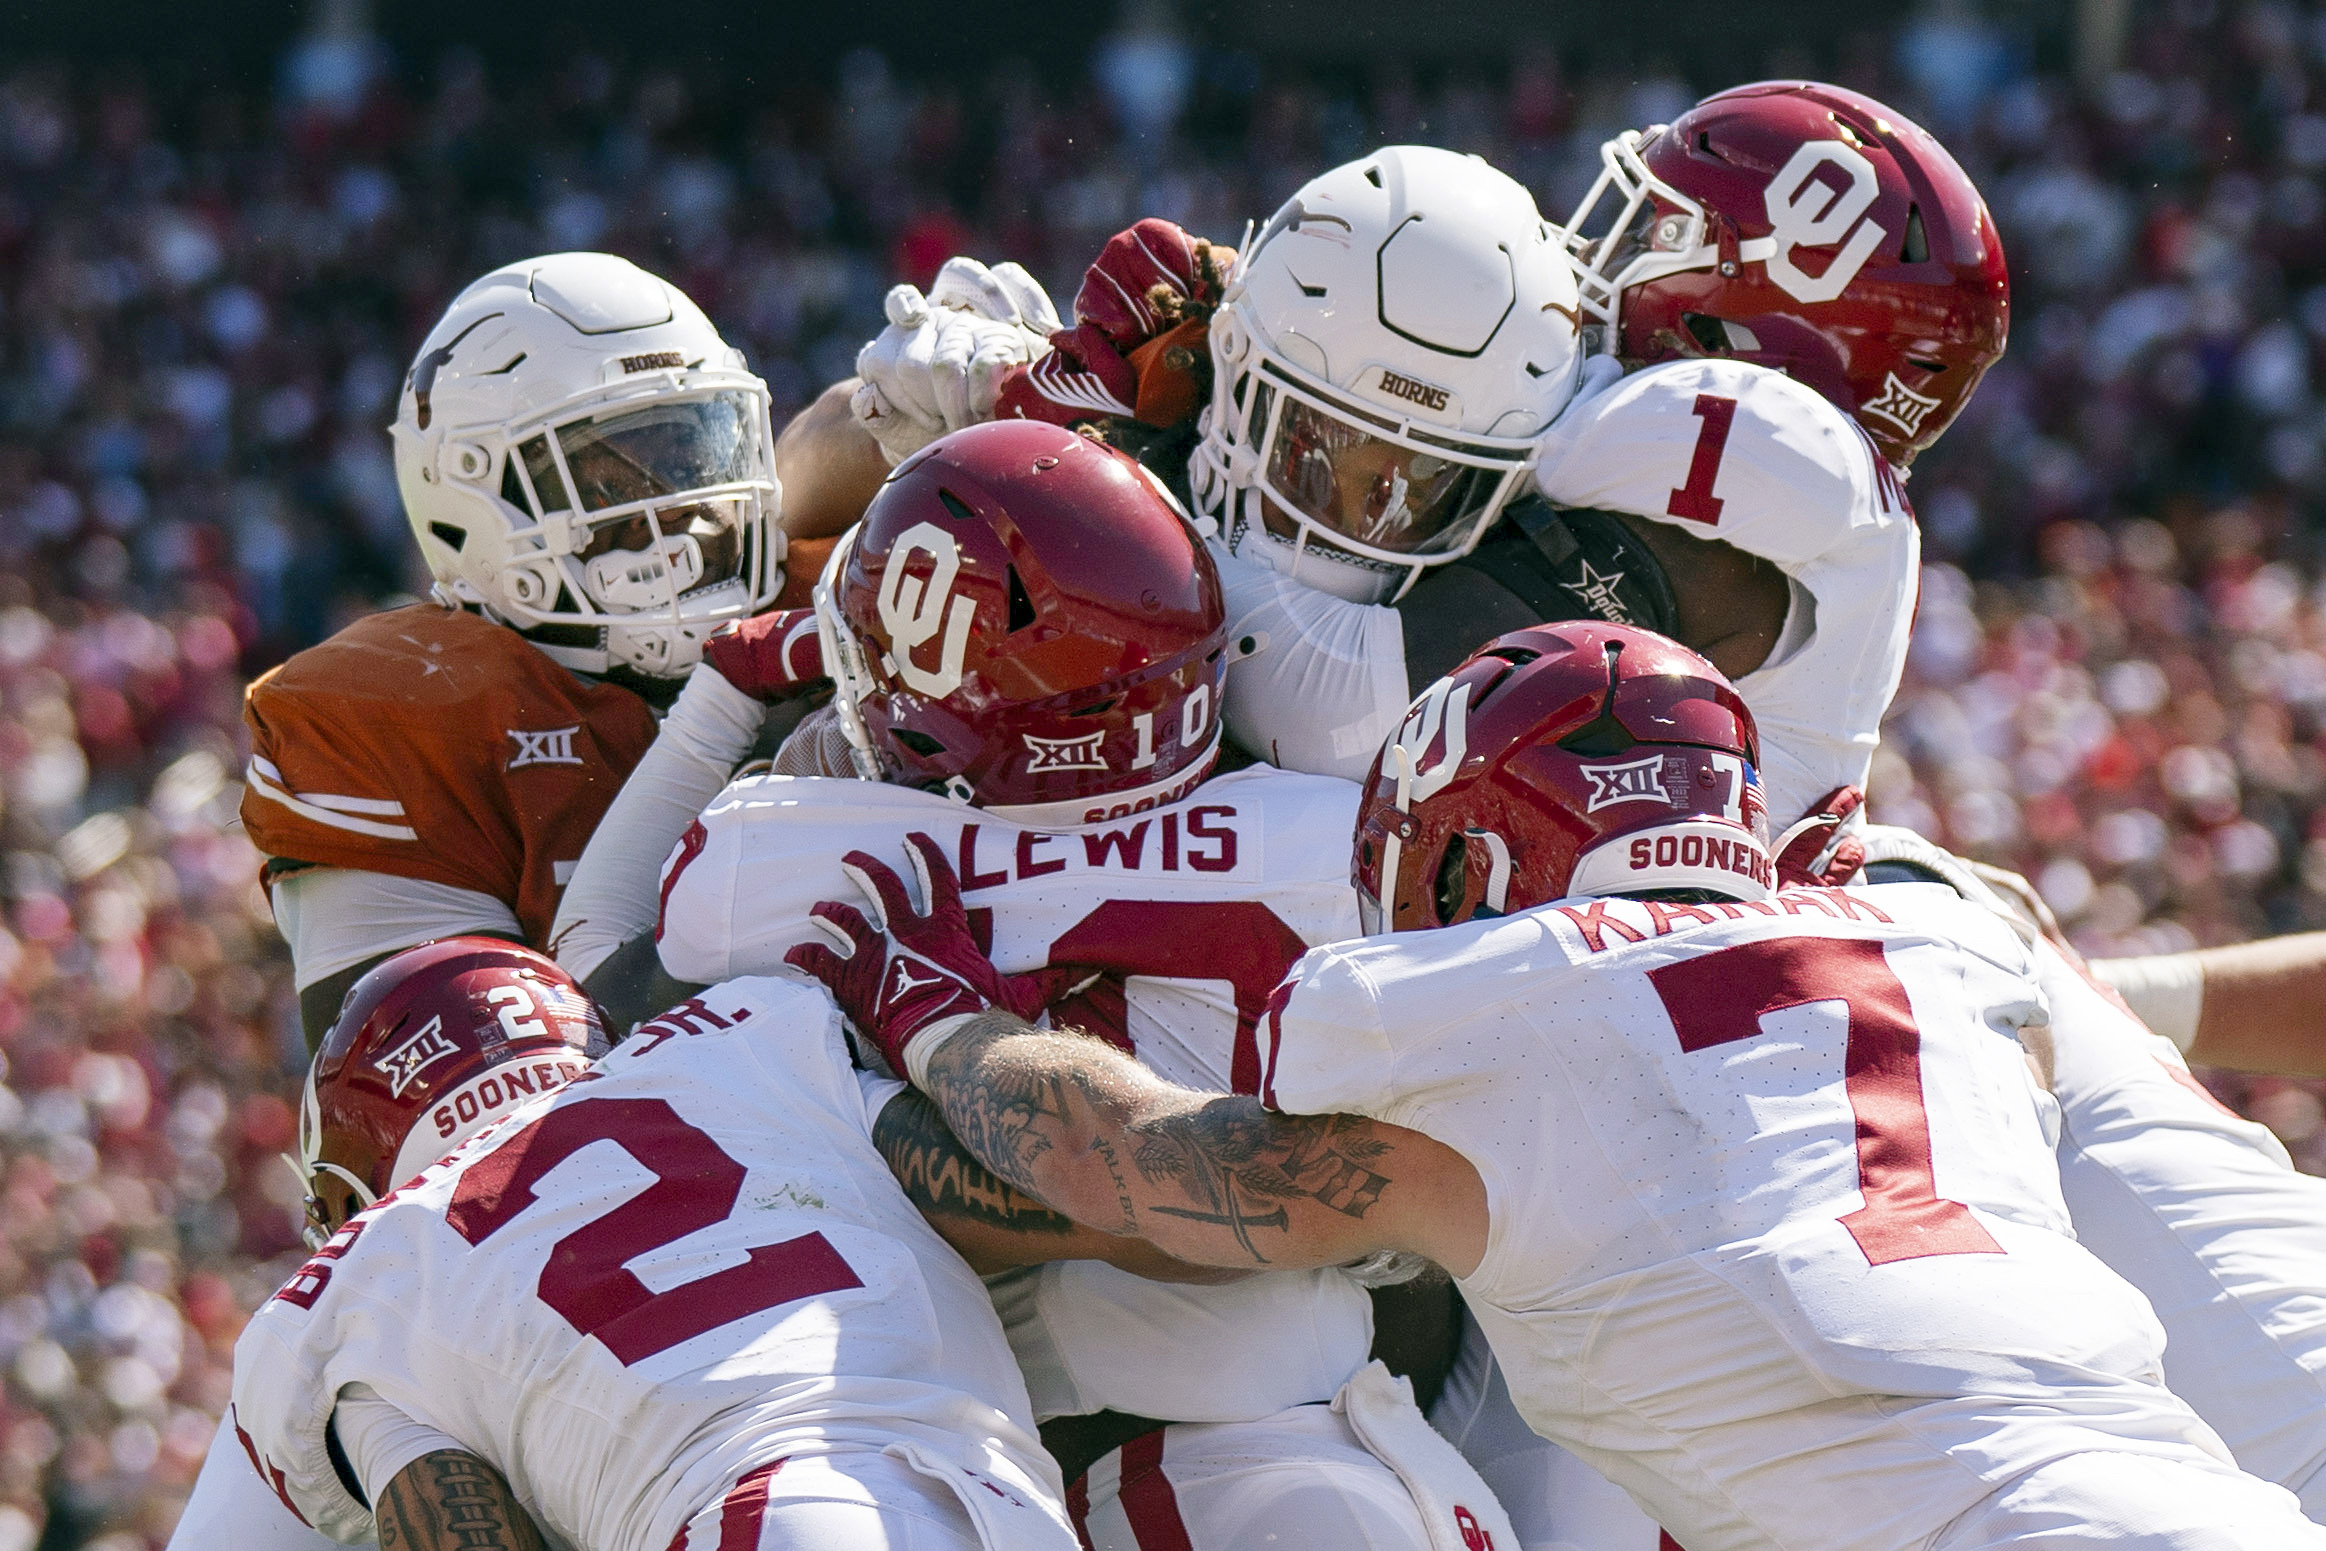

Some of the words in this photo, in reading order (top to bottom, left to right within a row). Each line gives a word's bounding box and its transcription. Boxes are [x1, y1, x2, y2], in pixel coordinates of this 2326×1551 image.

[620, 352, 684, 374] HORNS
[1379, 370, 1450, 411] HORNS
[1861, 371, 1942, 438] XII
[1667, 394, 1737, 526] 1
[877, 521, 977, 699] OU
[507, 725, 583, 768] XII
[1023, 729, 1109, 773] XII
[1132, 684, 1209, 770] 10
[1580, 753, 1671, 813] XII
[1711, 753, 1742, 823] 7
[959, 805, 1238, 892] LEWIS
[1630, 835, 1774, 890] SOONERS
[374, 1015, 460, 1098] XII
[486, 985, 549, 1039] 2
[433, 1061, 595, 1138] SOONER
[1646, 936, 2007, 1267] 7
[444, 1097, 866, 1367] 2
